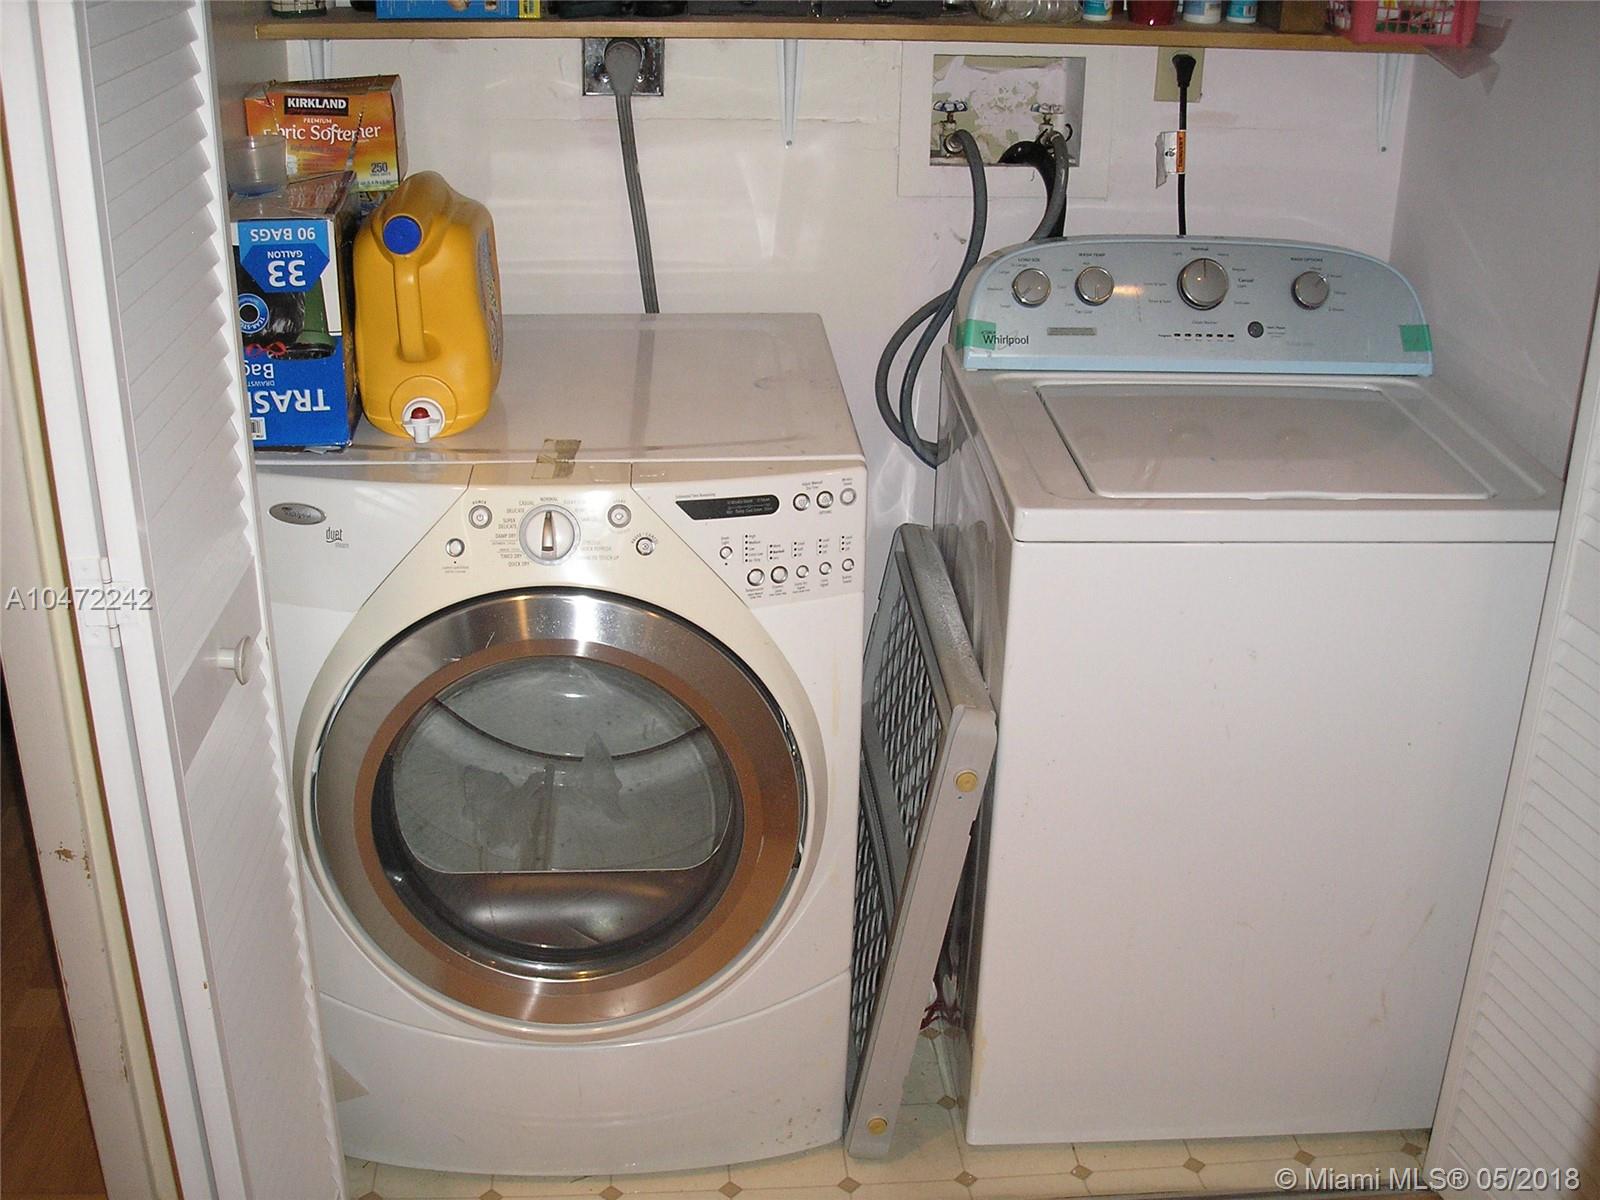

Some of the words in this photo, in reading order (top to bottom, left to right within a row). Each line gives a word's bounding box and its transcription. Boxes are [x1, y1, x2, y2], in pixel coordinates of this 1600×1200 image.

[287, 97, 347, 109] KIRKLAND
[303, 117, 333, 125] PREMIUM
[370, 162, 388, 173] 250
[250, 228, 293, 241] BAGS
[298, 227, 316, 240] 90
[267, 250, 303, 259] GALLON
[267, 260, 306, 287] 33
[982, 334, 1029, 346] Whirlpool
[325, 527, 343, 540] duet
